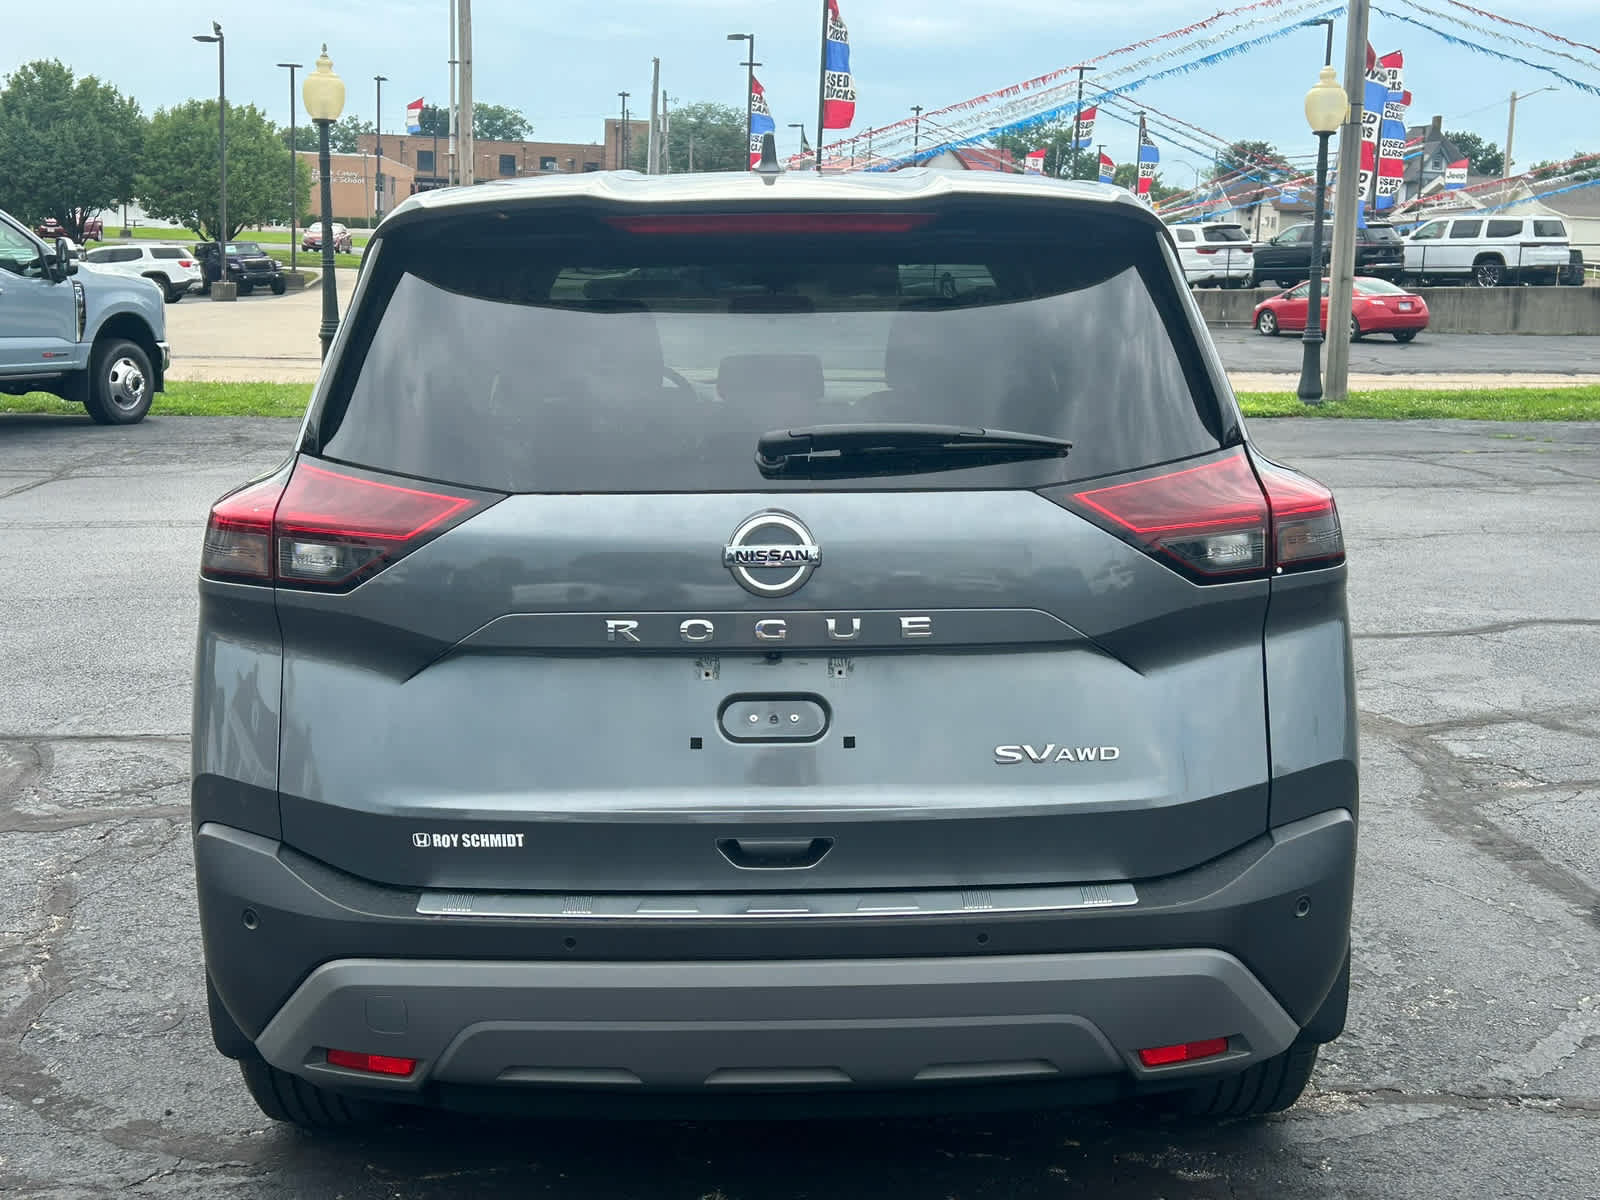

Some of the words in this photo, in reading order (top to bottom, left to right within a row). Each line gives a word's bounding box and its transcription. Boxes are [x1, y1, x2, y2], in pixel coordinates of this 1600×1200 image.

[1382, 139, 1405, 149] USED
[1382, 148, 1403, 158] CARS
[1379, 186, 1397, 195] CAR
[735, 550, 809, 562] NISSAN
[605, 616, 933, 642] ROGUE
[432, 833, 459, 848] ROY
[461, 833, 525, 848] SCHMIDT
